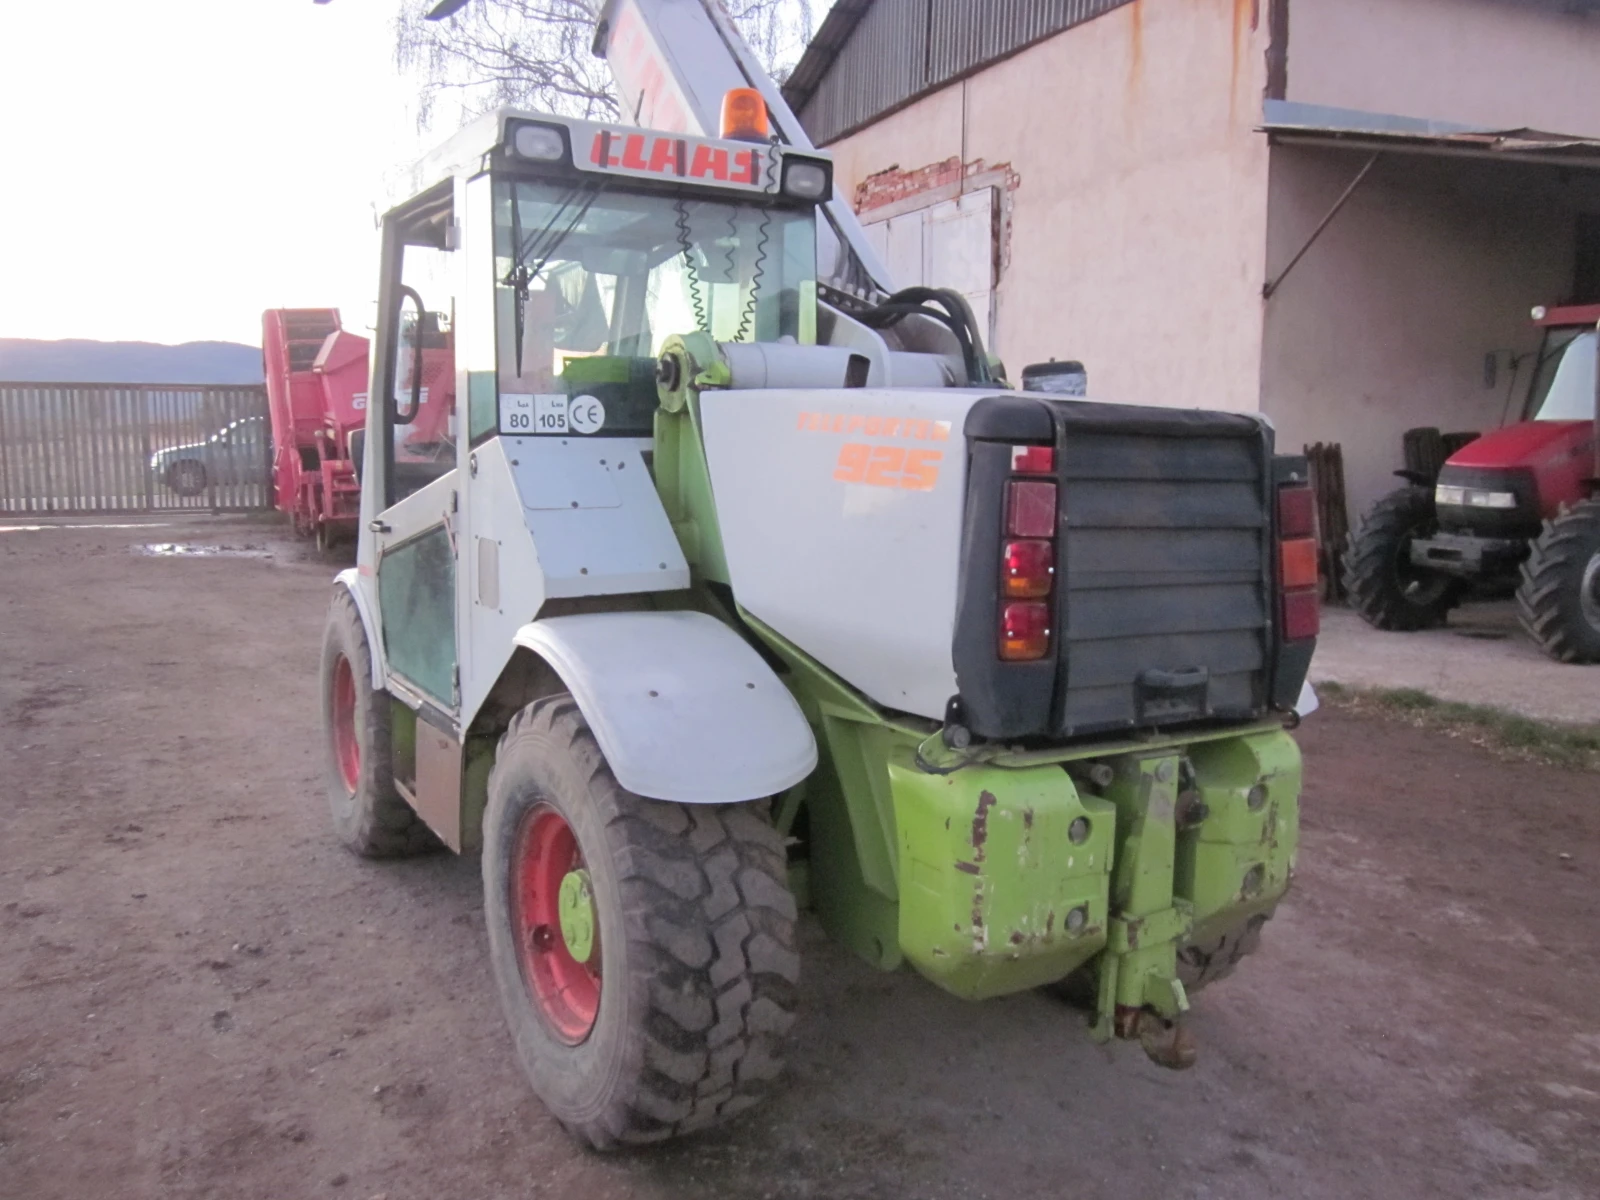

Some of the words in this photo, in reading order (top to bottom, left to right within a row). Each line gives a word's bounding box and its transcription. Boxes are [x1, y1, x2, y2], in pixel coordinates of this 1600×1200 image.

[590, 131, 764, 185] CLAAS
[510, 413, 529, 428] 80
[539, 413, 566, 428] 105
[573, 405, 598, 425] CE
[833, 442, 943, 492] 925
